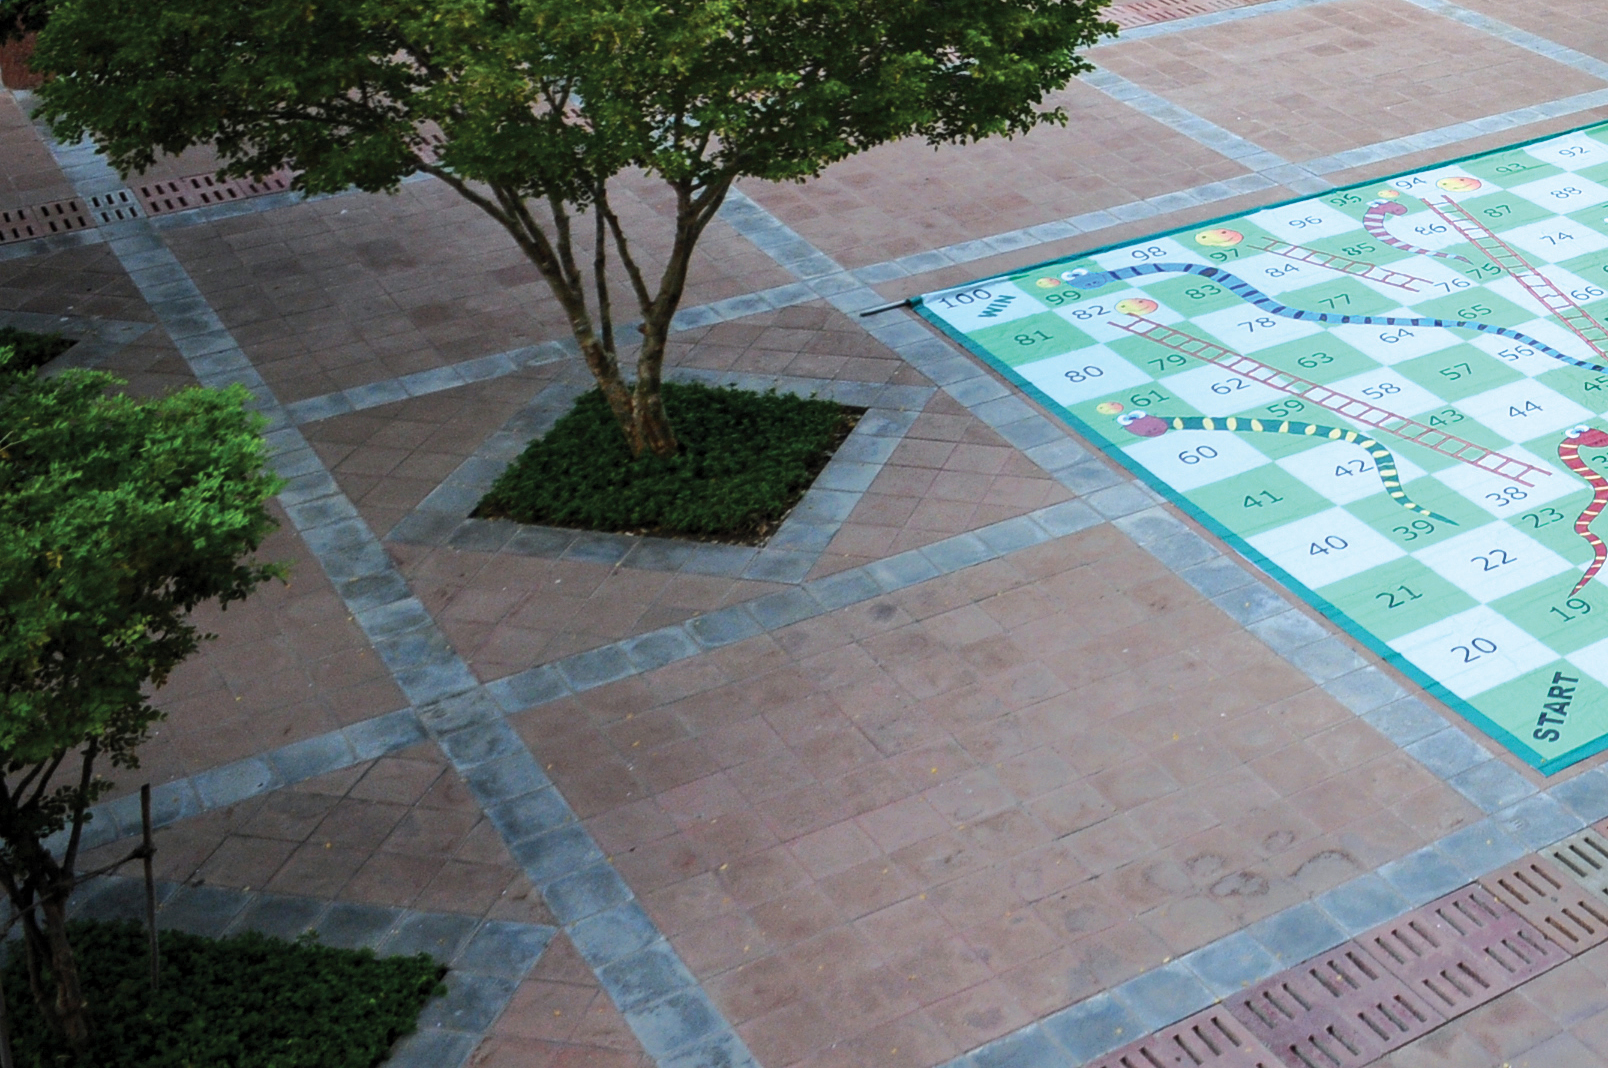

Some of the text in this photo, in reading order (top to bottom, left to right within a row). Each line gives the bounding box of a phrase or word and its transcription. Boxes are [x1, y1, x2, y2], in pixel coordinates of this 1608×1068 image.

[1559, 147, 1589, 157] 92
[1496, 163, 1526, 175] 93
[1397, 177, 1427, 190] 94
[1330, 193, 1363, 207] 95
[1551, 187, 1582, 198] 88
[1484, 205, 1511, 217] 87
[1289, 216, 1322, 228] 96
[1540, 232, 1573, 245] 74
[1132, 247, 1167, 261] 98
[1210, 247, 1241, 262] 97
[1342, 243, 1375, 255] 85
[1265, 264, 1299, 277] 84
[1466, 263, 1501, 279] 75
[1185, 285, 1221, 299] 83
[1434, 279, 1470, 292] 76
[938, 287, 992, 310] 100
[1046, 291, 1081, 305] 99
[1571, 287, 1603, 300] 66
[978, 293, 1016, 319] WIN
[1318, 294, 1350, 309] 77
[1073, 306, 1111, 319] 82
[1458, 304, 1491, 319] 65
[1237, 318, 1276, 332] 78
[1014, 330, 1053, 345] 81
[1380, 329, 1414, 343] 64
[1298, 353, 1333, 368] 63
[1498, 346, 1534, 361] 56
[1148, 354, 1187, 371] 79
[1065, 366, 1103, 382] 80
[1440, 363, 1471, 380] 57
[1211, 378, 1250, 394] 62
[1362, 383, 1401, 399] 58
[1130, 390, 1169, 407] 61
[1266, 400, 1304, 417] 59
[1510, 401, 1542, 417] 44
[1430, 410, 1464, 426] 43
[1179, 446, 1217, 464] 60
[1336, 460, 1374, 476] 42
[1244, 490, 1283, 507] 41
[1485, 487, 1527, 507] 38
[1522, 508, 1564, 528] 23
[1393, 520, 1434, 541] 39
[1310, 536, 1348, 555] 40
[1471, 549, 1517, 571] 22
[1376, 586, 1423, 608] 21
[1550, 599, 1590, 622] 19
[1451, 638, 1497, 663] 20
[1533, 671, 1579, 742] START
